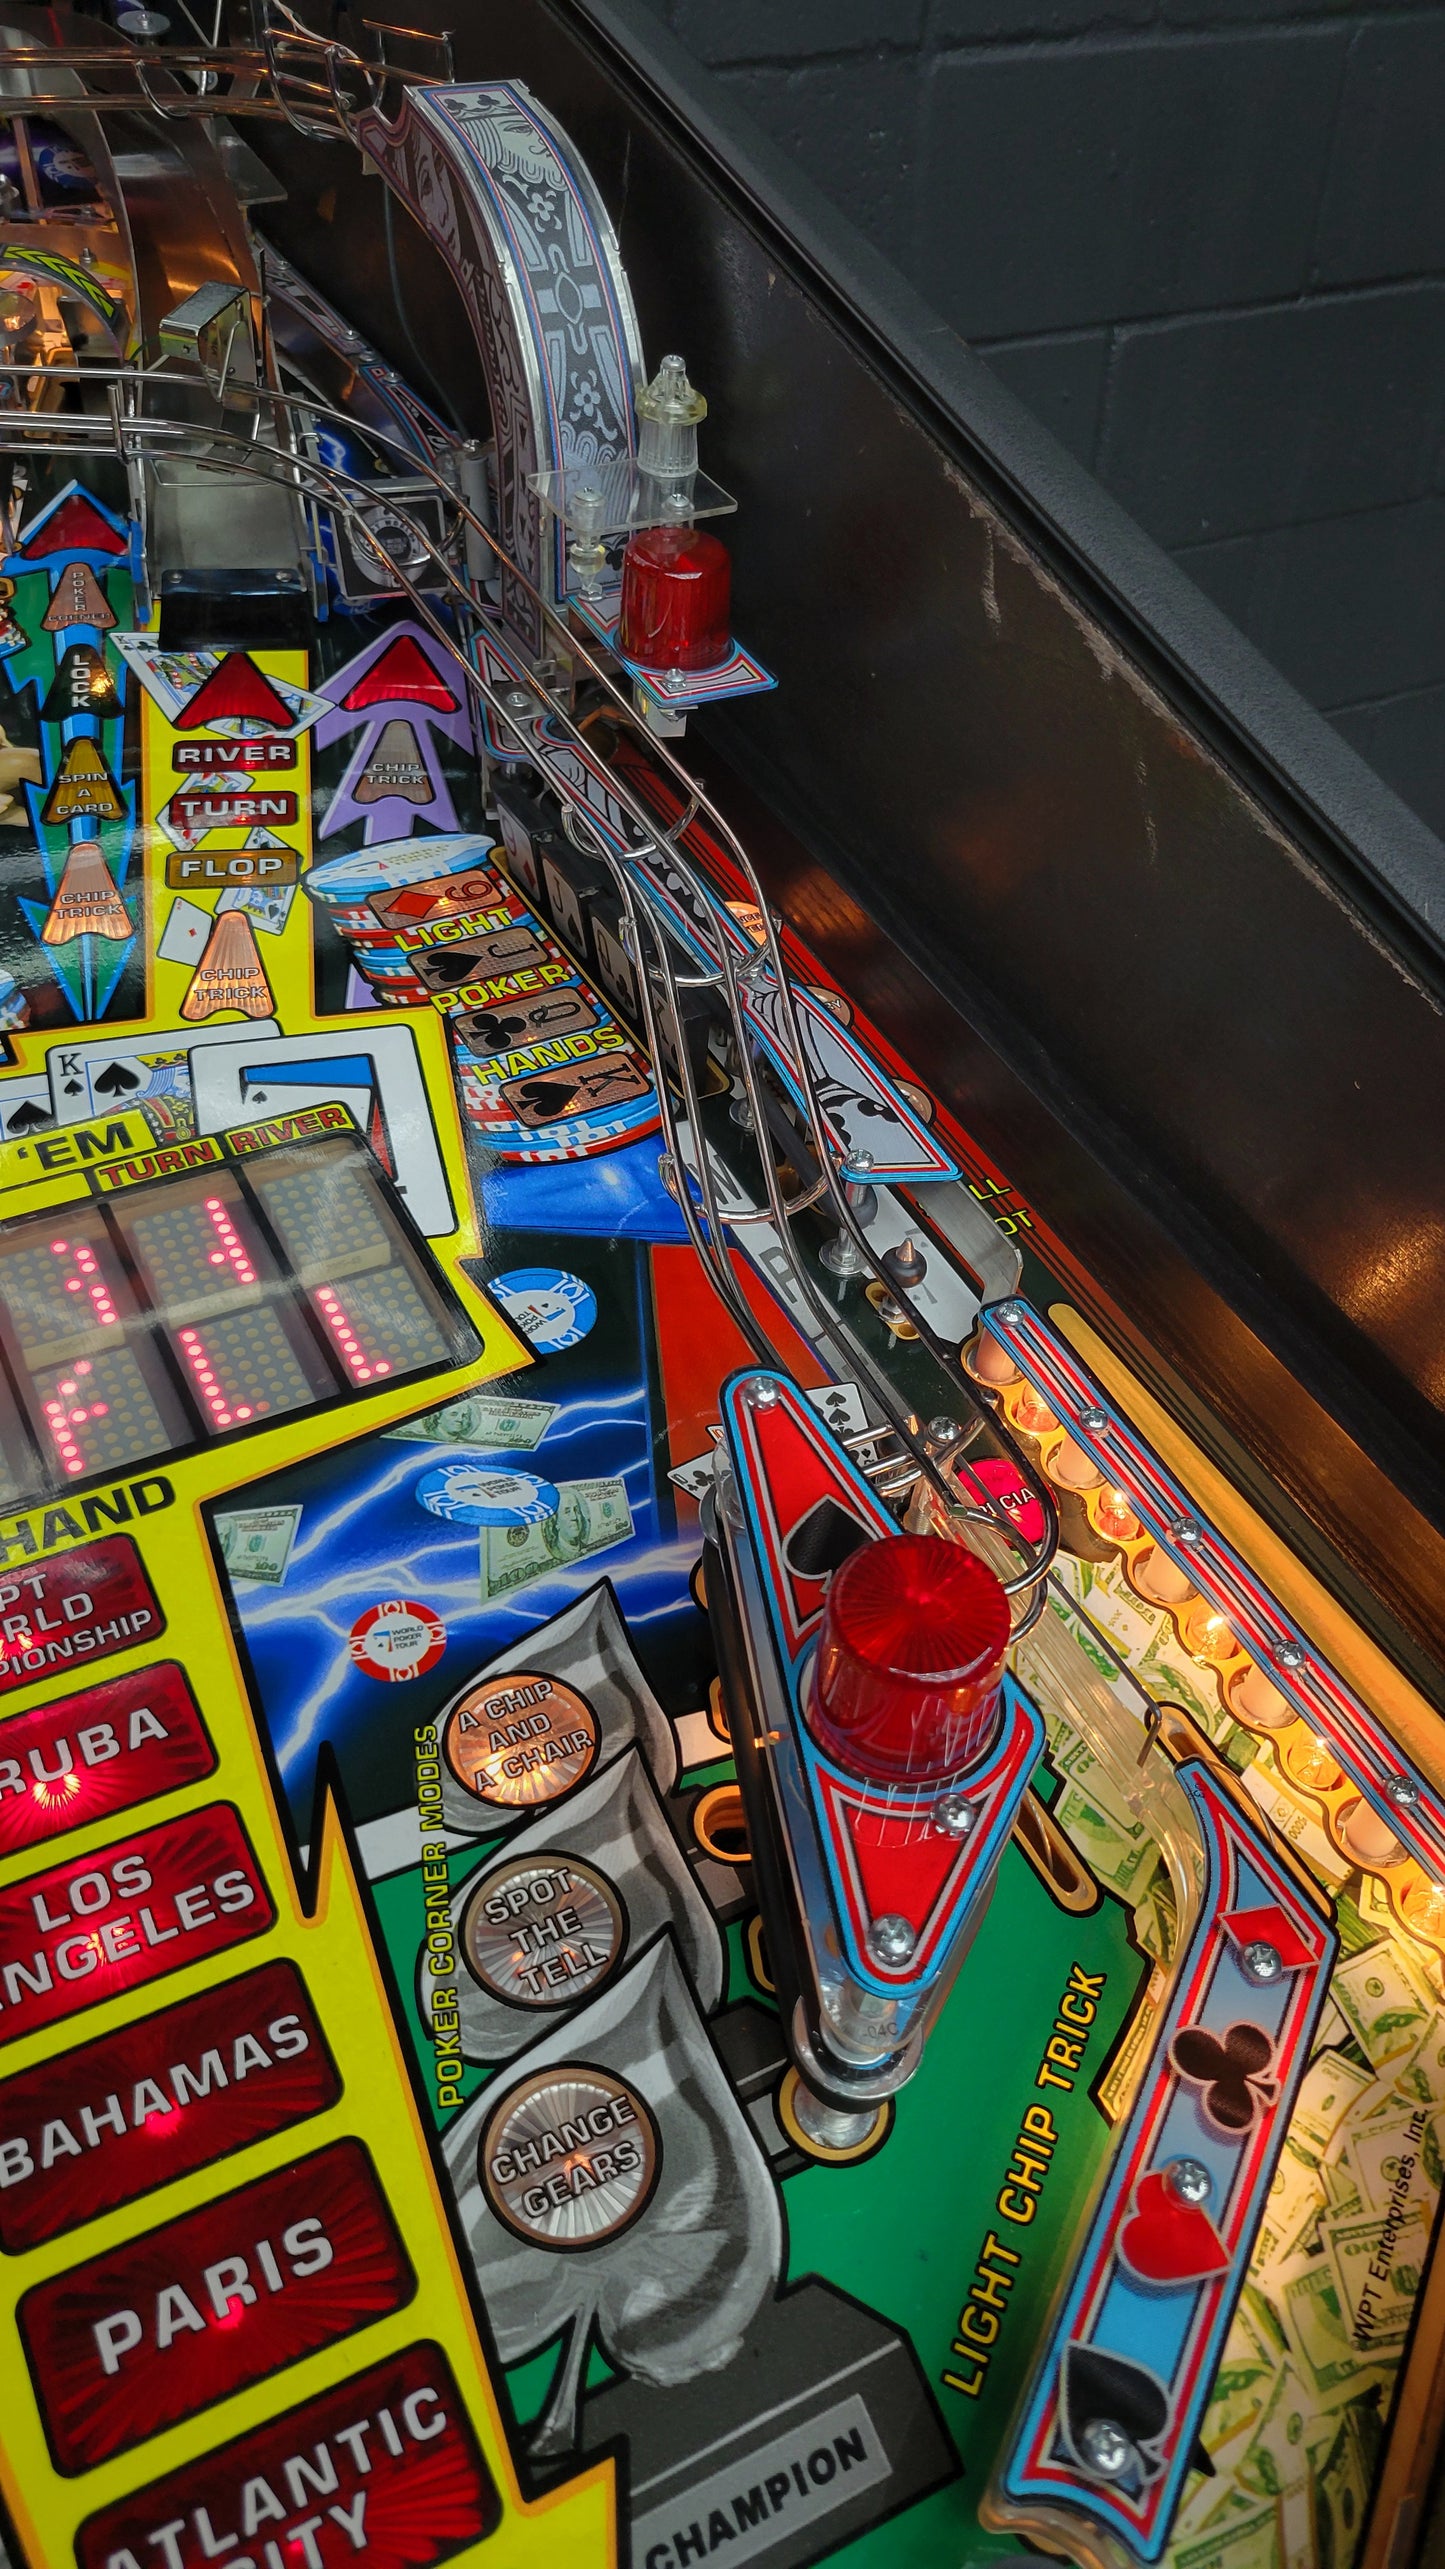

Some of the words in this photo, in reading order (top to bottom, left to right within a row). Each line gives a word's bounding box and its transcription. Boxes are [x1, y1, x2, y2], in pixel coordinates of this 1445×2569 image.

[72, 572, 86, 611] POKER
[70, 655, 91, 708] LOCK
[58, 772, 109, 783] SPIN
[178, 745, 291, 763] RIVER
[372, 763, 420, 773] CHIP
[78, 788, 91, 798] A
[367, 775, 425, 785] TRICK
[56, 802, 113, 814] CARD
[180, 799, 287, 817] TURN
[181, 858, 283, 877] FLOP
[56, 904, 123, 919] TRICK
[60, 891, 116, 904] CHIP
[393, 906, 513, 953] LIGHT
[194, 985, 268, 1000] TRICK
[200, 968, 260, 981] CHIP
[430, 962, 572, 1014] POKER
[58, 1053, 84, 1077] K
[473, 1026, 626, 1085] HANDS
[230, 1108, 347, 1154] RIVER
[98, 1141, 216, 1187] TURN
[0, 1476, 176, 1564] HAND
[392, 1625, 424, 1636] WORLD
[394, 1633, 422, 1643] POKER
[395, 1641, 418, 1650] TOUR
[458, 1710, 479, 1733] A
[485, 1679, 553, 1721] CHIP
[489, 1711, 550, 1752] AND
[414, 1723, 445, 1834] MODES
[474, 1769, 495, 1792] A
[498, 1728, 594, 1778] CHAIR
[32, 1854, 153, 1933] LOS
[424, 1839, 456, 1978] CORNER
[484, 1867, 574, 1925] SPOT
[0, 1869, 256, 2011] NGELES
[510, 1907, 583, 1956] THE
[520, 1942, 609, 1996] TELL
[435, 1986, 465, 2109] POKER
[0, 2013, 310, 2189] BAHAMAS
[491, 2095, 637, 2186] CHANGE
[1403, 2107, 1430, 2145] Inc.
[522, 2142, 641, 2220] GEARS
[941, 2231, 1022, 2399] LIGHT
[997, 2104, 1058, 2227] CHIP
[1036, 1962, 1107, 2092] TRICK
[92, 2217, 334, 2376] PARIS
[645, 2427, 869, 2569] CHAMPION
[221, 2491, 367, 2569] ITY
